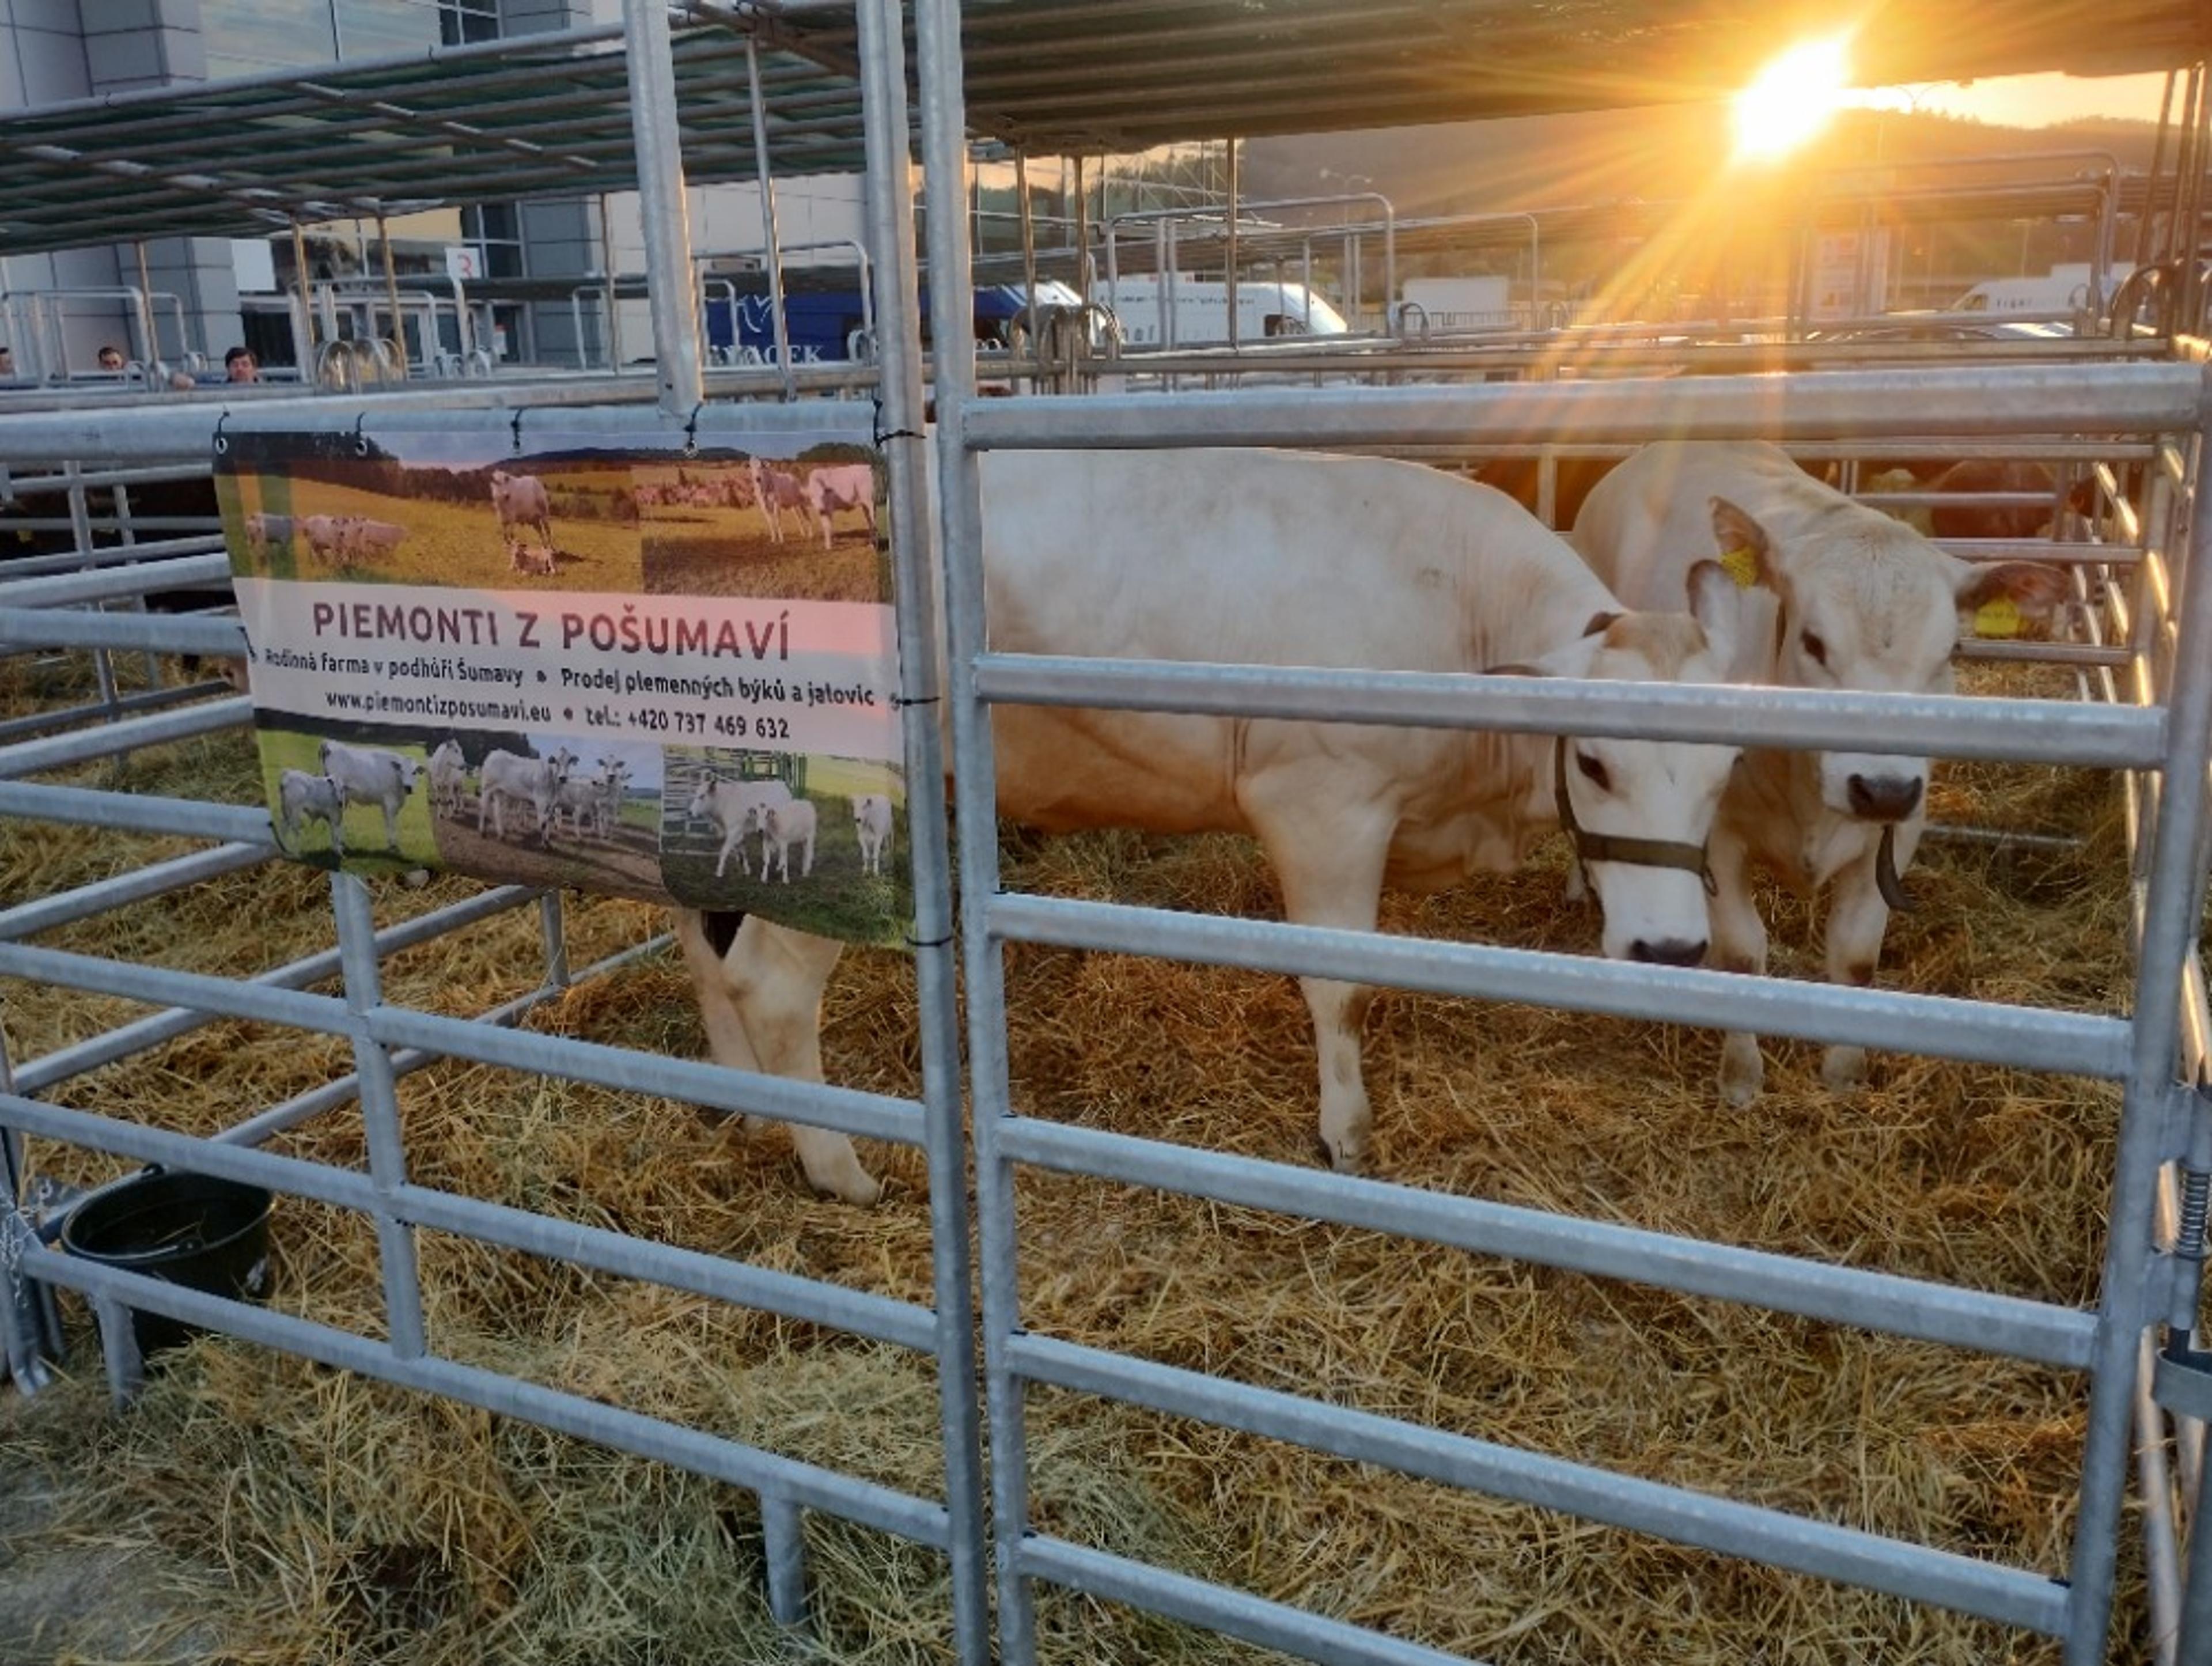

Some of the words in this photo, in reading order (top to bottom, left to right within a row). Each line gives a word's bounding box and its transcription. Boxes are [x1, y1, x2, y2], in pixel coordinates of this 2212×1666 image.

[313, 603, 498, 646] PIEMONTI
[516, 611, 540, 648] Z
[562, 603, 789, 661] POŠUMAVÍ
[266, 648, 316, 672] Rodinná
[321, 652, 369, 673] farma
[374, 662, 383, 675] v
[388, 657, 453, 680] podhůří
[457, 657, 522, 688] Šumavy
[561, 667, 619, 694] Prodej
[626, 670, 733, 701] plemenných
[738, 676, 785, 704] býků
[792, 686, 802, 702] a
[808, 681, 874, 707] jalovic
[325, 691, 551, 722] www.piemontizposumavi.eu
[586, 705, 621, 726] tel.:
[628, 709, 668, 730] +420
[674, 712, 706, 734] 737
[714, 715, 747, 736] 469
[756, 718, 790, 739] 632
